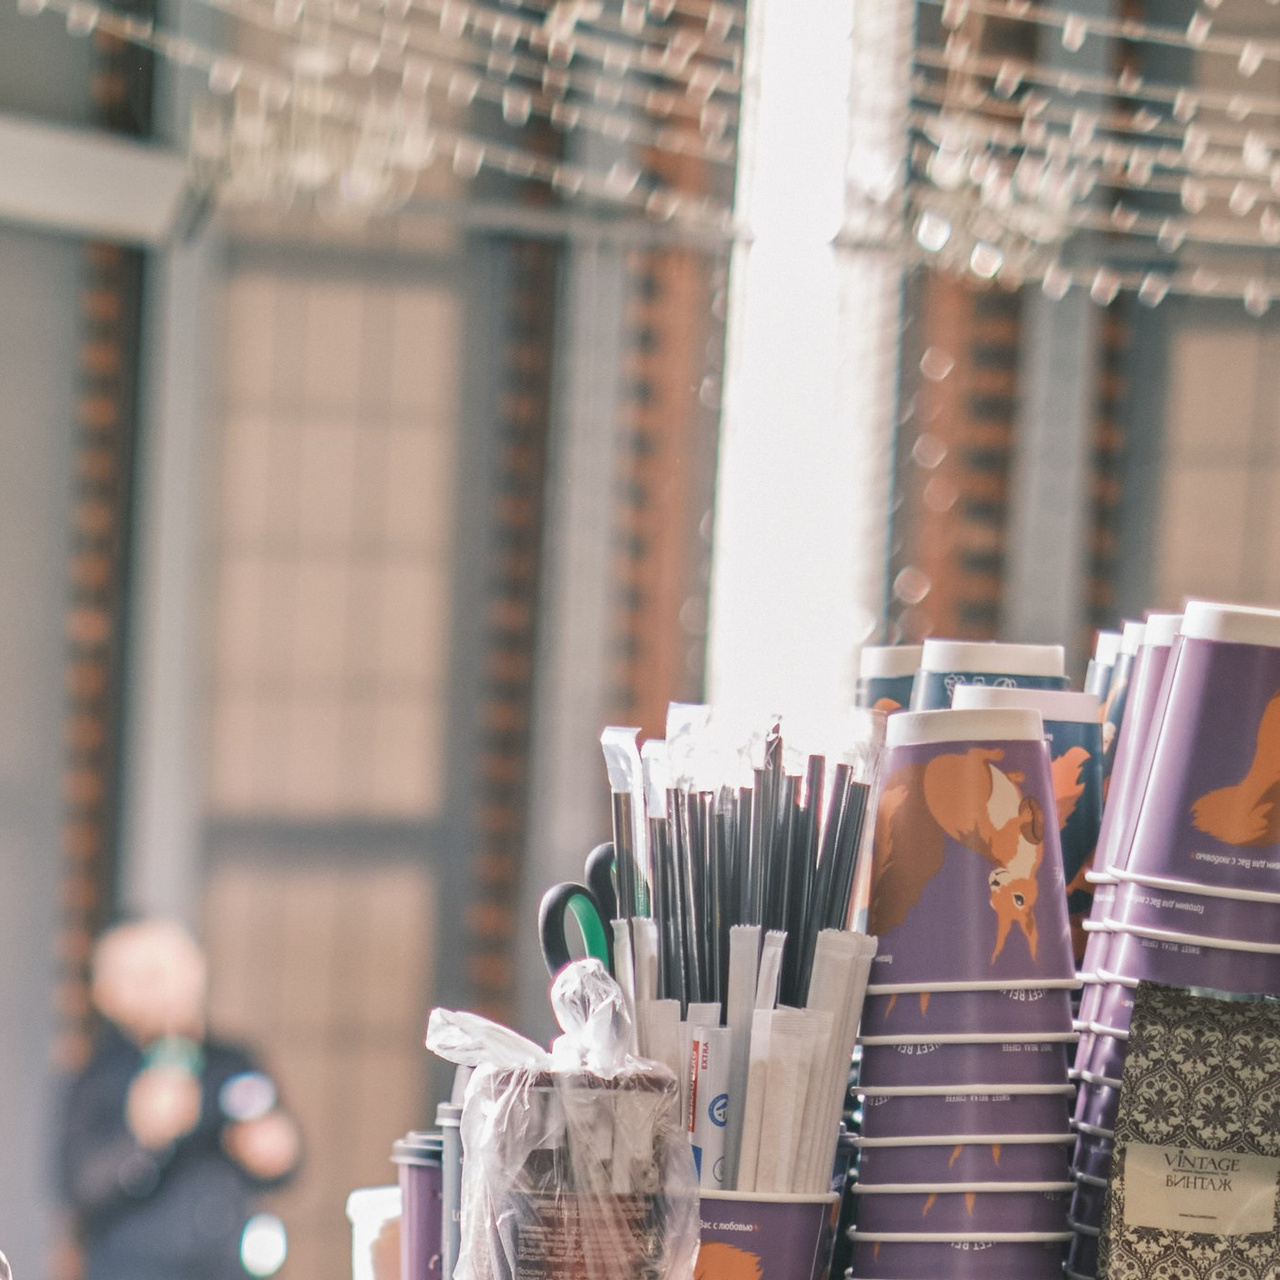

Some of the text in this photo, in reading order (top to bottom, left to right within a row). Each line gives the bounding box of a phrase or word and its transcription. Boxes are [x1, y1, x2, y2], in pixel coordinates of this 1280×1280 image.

[1196, 853, 1231, 866] любовью
[701, 1042, 709, 1070] EXTRA
[1166, 1174, 1233, 1192] ВИНТАЖ
[718, 1221, 754, 1232] любовью
